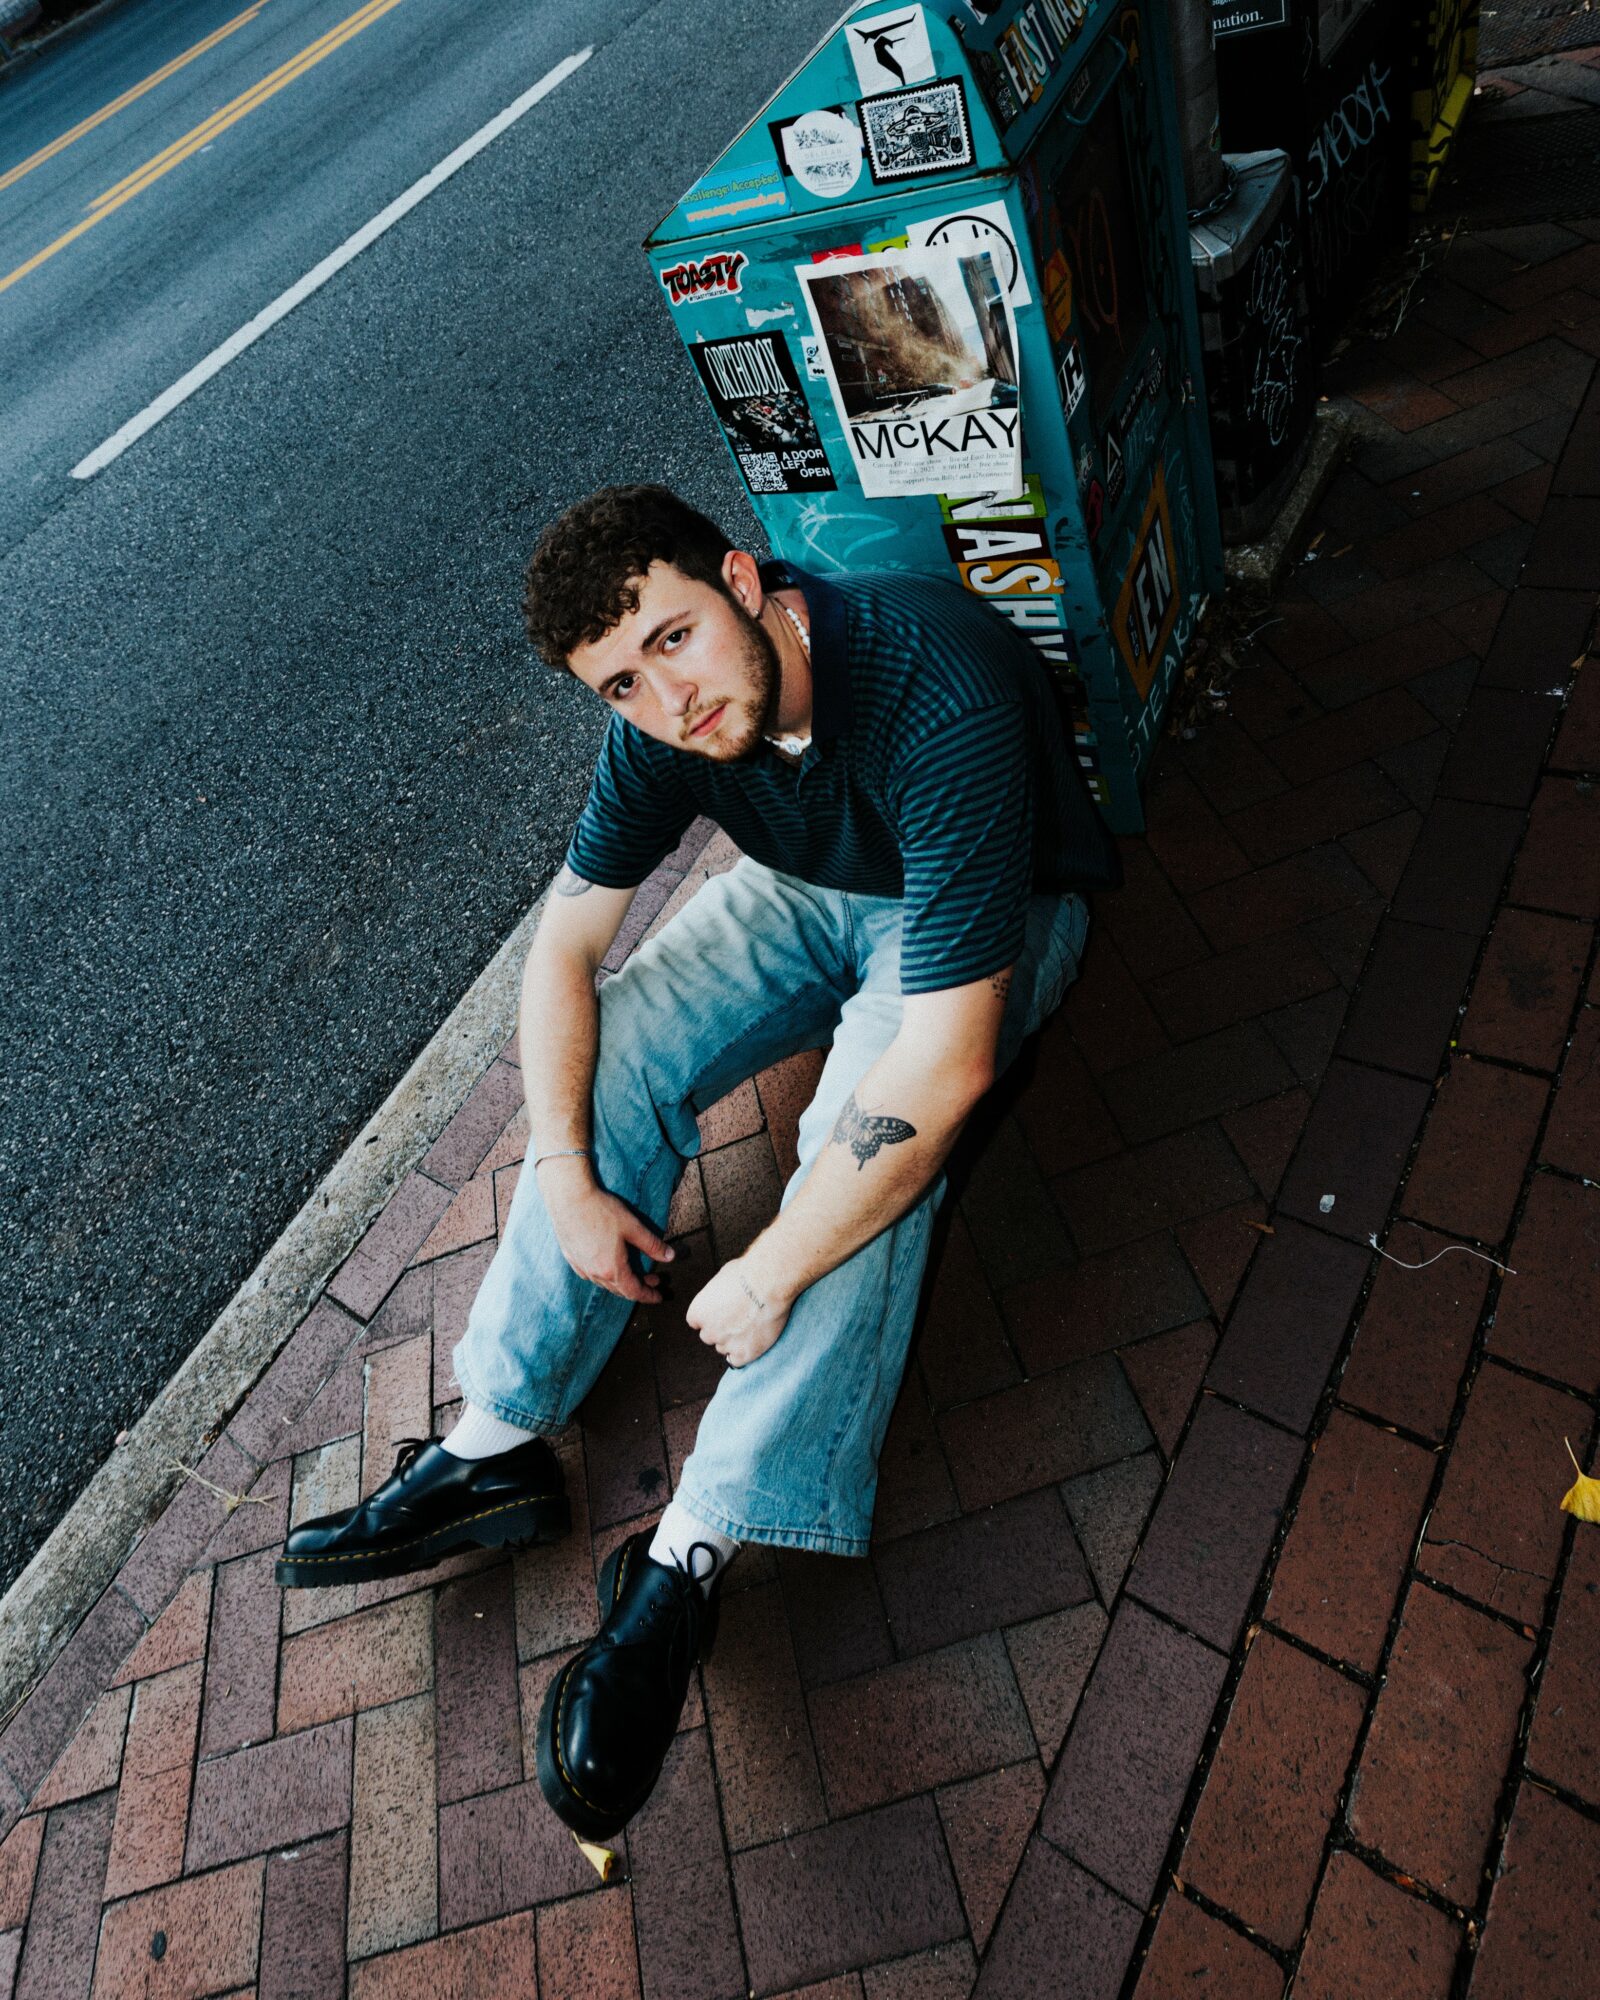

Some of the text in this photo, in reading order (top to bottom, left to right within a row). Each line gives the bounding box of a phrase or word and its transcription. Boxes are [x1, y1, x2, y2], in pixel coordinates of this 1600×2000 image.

[1000, 3, 1056, 104] EAST
[661, 253, 746, 304] TOASTY
[704, 338, 790, 400] ORTHODOX
[781, 459, 806, 470] LEFT
[782, 449, 824, 460] A DOOR
[800, 467, 831, 478] OPEN
